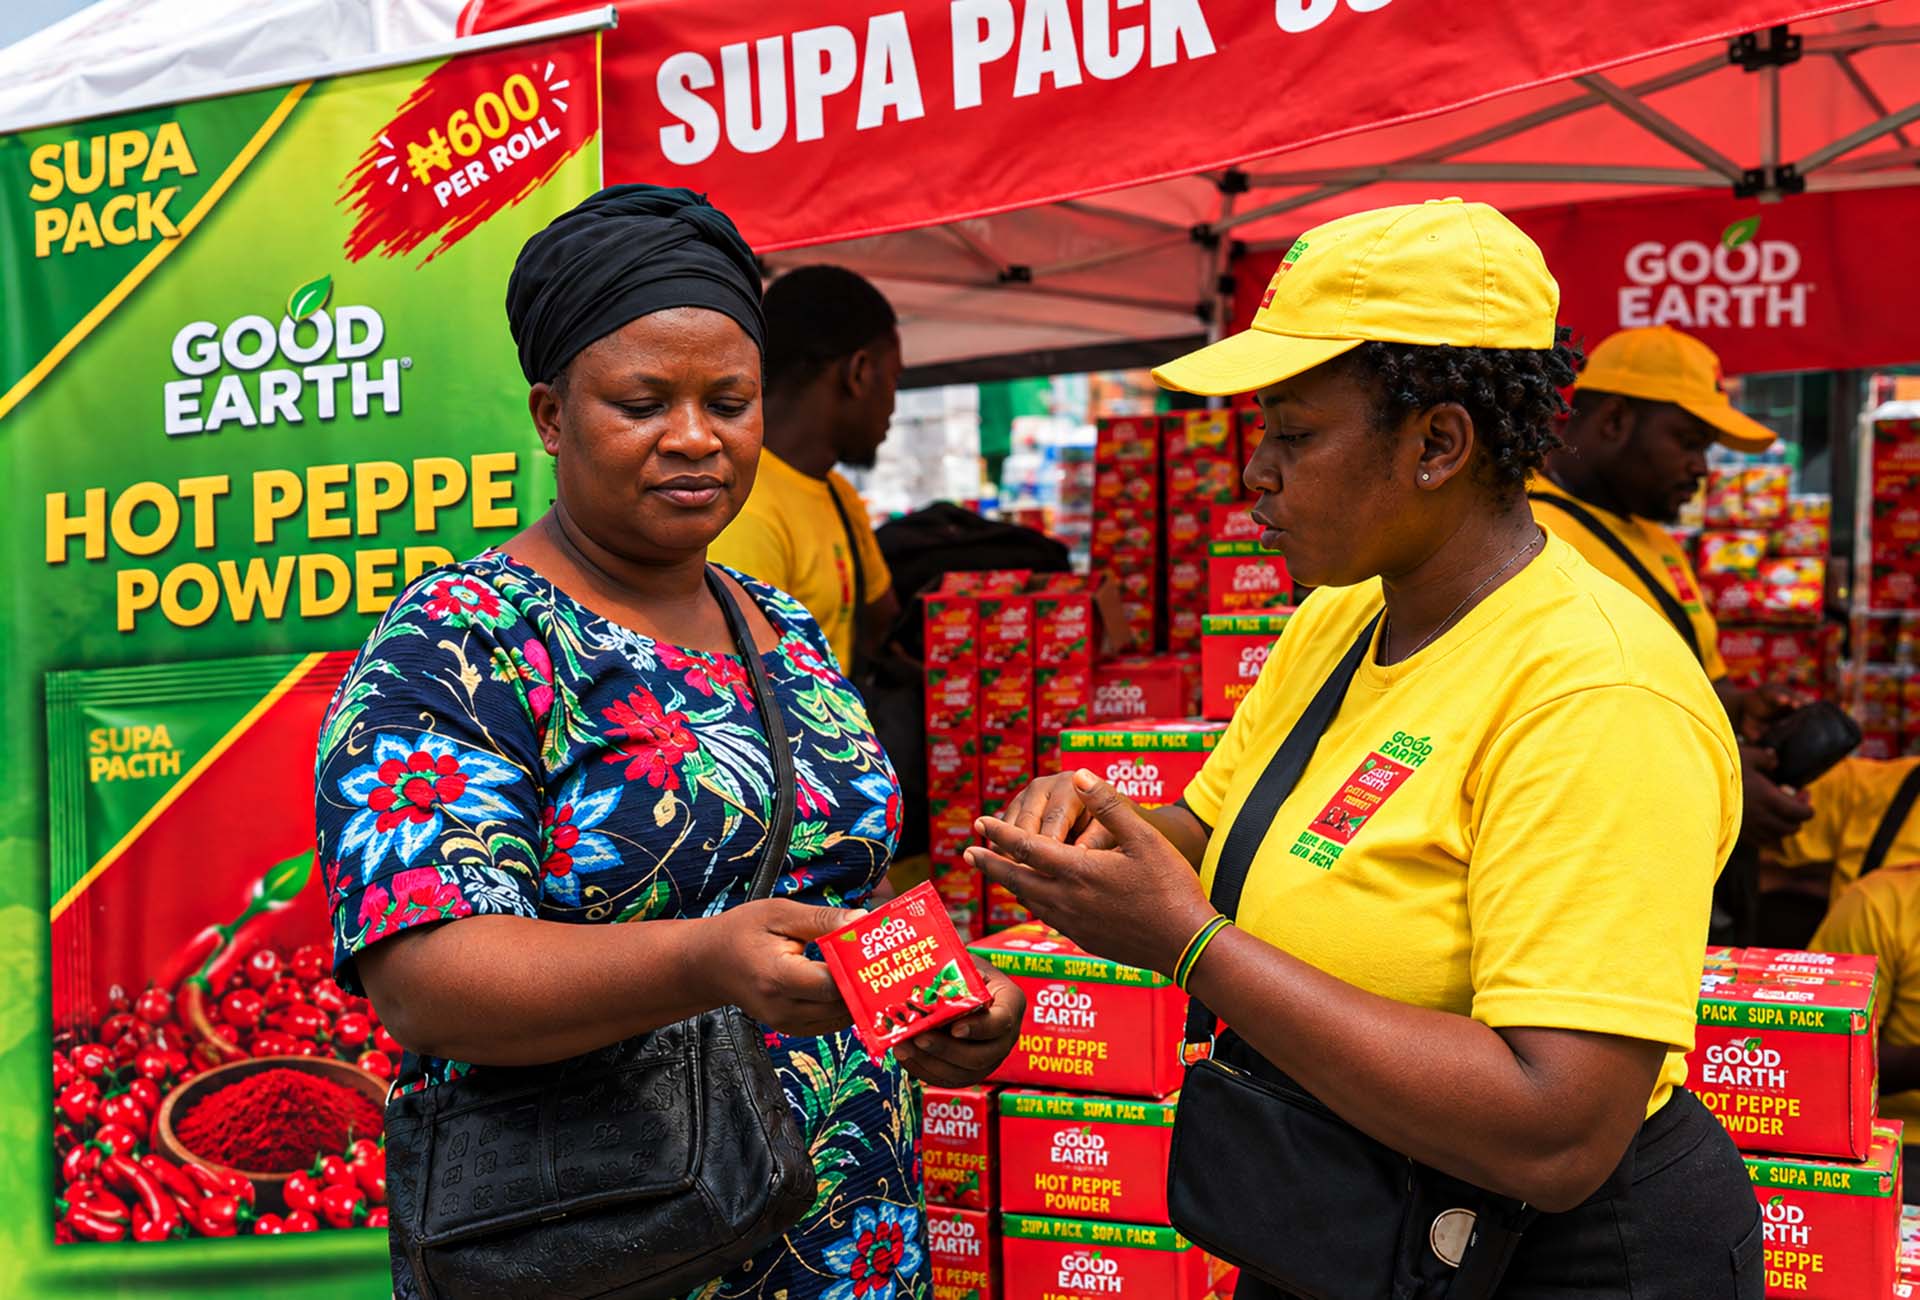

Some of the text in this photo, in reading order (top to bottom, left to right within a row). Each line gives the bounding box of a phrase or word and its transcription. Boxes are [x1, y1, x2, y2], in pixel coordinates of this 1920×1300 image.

[656, 11, 925, 166] SUPA
[29, 122, 198, 203] SUPA
[433, 117, 561, 208] PER ROLL
[34, 187, 182, 257] PACK
[1625, 241, 1801, 284] GOOD
[1617, 284, 1807, 327] EARTH
[172, 305, 385, 377] GOOD
[253, 452, 518, 543] PEPPE
[45, 475, 229, 563] HOT
[1094, 700, 1145, 714] EARTH
[90, 724, 173, 754] SUPA
[1392, 731, 1433, 756] GOOD
[1378, 741, 1426, 768] EARTH
[90, 751, 180, 783] PACTH
[1106, 765, 1158, 780] GOOD
[861, 918, 906, 946] GOOD
[862, 926, 917, 960] EARTH
[858, 936, 939, 983] HOT PEPPE
[870, 953, 937, 994] POWDER
[1036, 990, 1092, 1010] GOOD
[1033, 1006, 1096, 1028] EARTH
[1702, 1004, 1825, 1027] PACK SUPA PACK
[1018, 1035, 1108, 1059] HOT PEPPE
[1706, 1045, 1782, 1068] GOOD
[1028, 1054, 1094, 1076] POWDER
[1702, 1064, 1786, 1088] EARTH
[927, 1102, 975, 1121] GOOD
[1116, 1104, 1146, 1120] PACK
[1736, 1095, 1801, 1117] PEPPE
[923, 1118, 980, 1139] EARTH
[1053, 1130, 1105, 1149] GOOD
[1050, 1147, 1109, 1167] EARTH
[1035, 1173, 1122, 1197] HOT PEPPE
[1769, 1167, 1807, 1186] SUPA
[1813, 1171, 1851, 1190] PACK
[1044, 1193, 1111, 1213] POWDER
[1126, 1227, 1157, 1245] PACK
[1060, 1254, 1118, 1275] GOOD
[1057, 1271, 1122, 1294] EARTH
